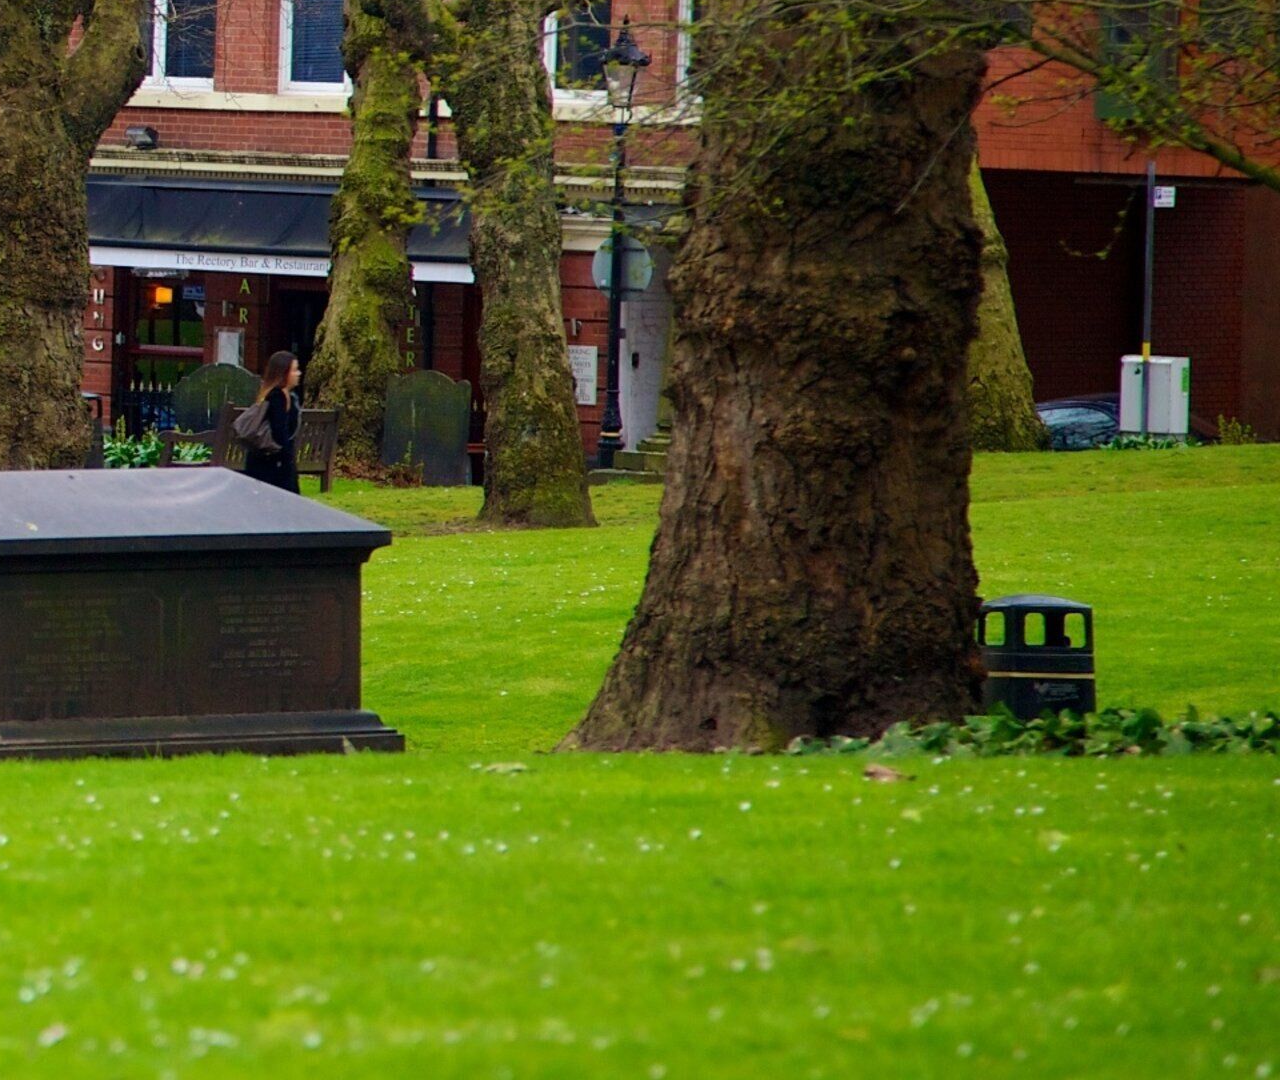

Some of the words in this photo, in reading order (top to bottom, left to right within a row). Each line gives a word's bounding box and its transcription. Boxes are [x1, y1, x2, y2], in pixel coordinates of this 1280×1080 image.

[175, 252, 193, 264] The
[197, 254, 236, 269] Rectory
[240, 256, 257, 268] Bar
[261, 257, 270, 269] &
[274, 258, 329, 271] Restaurant
